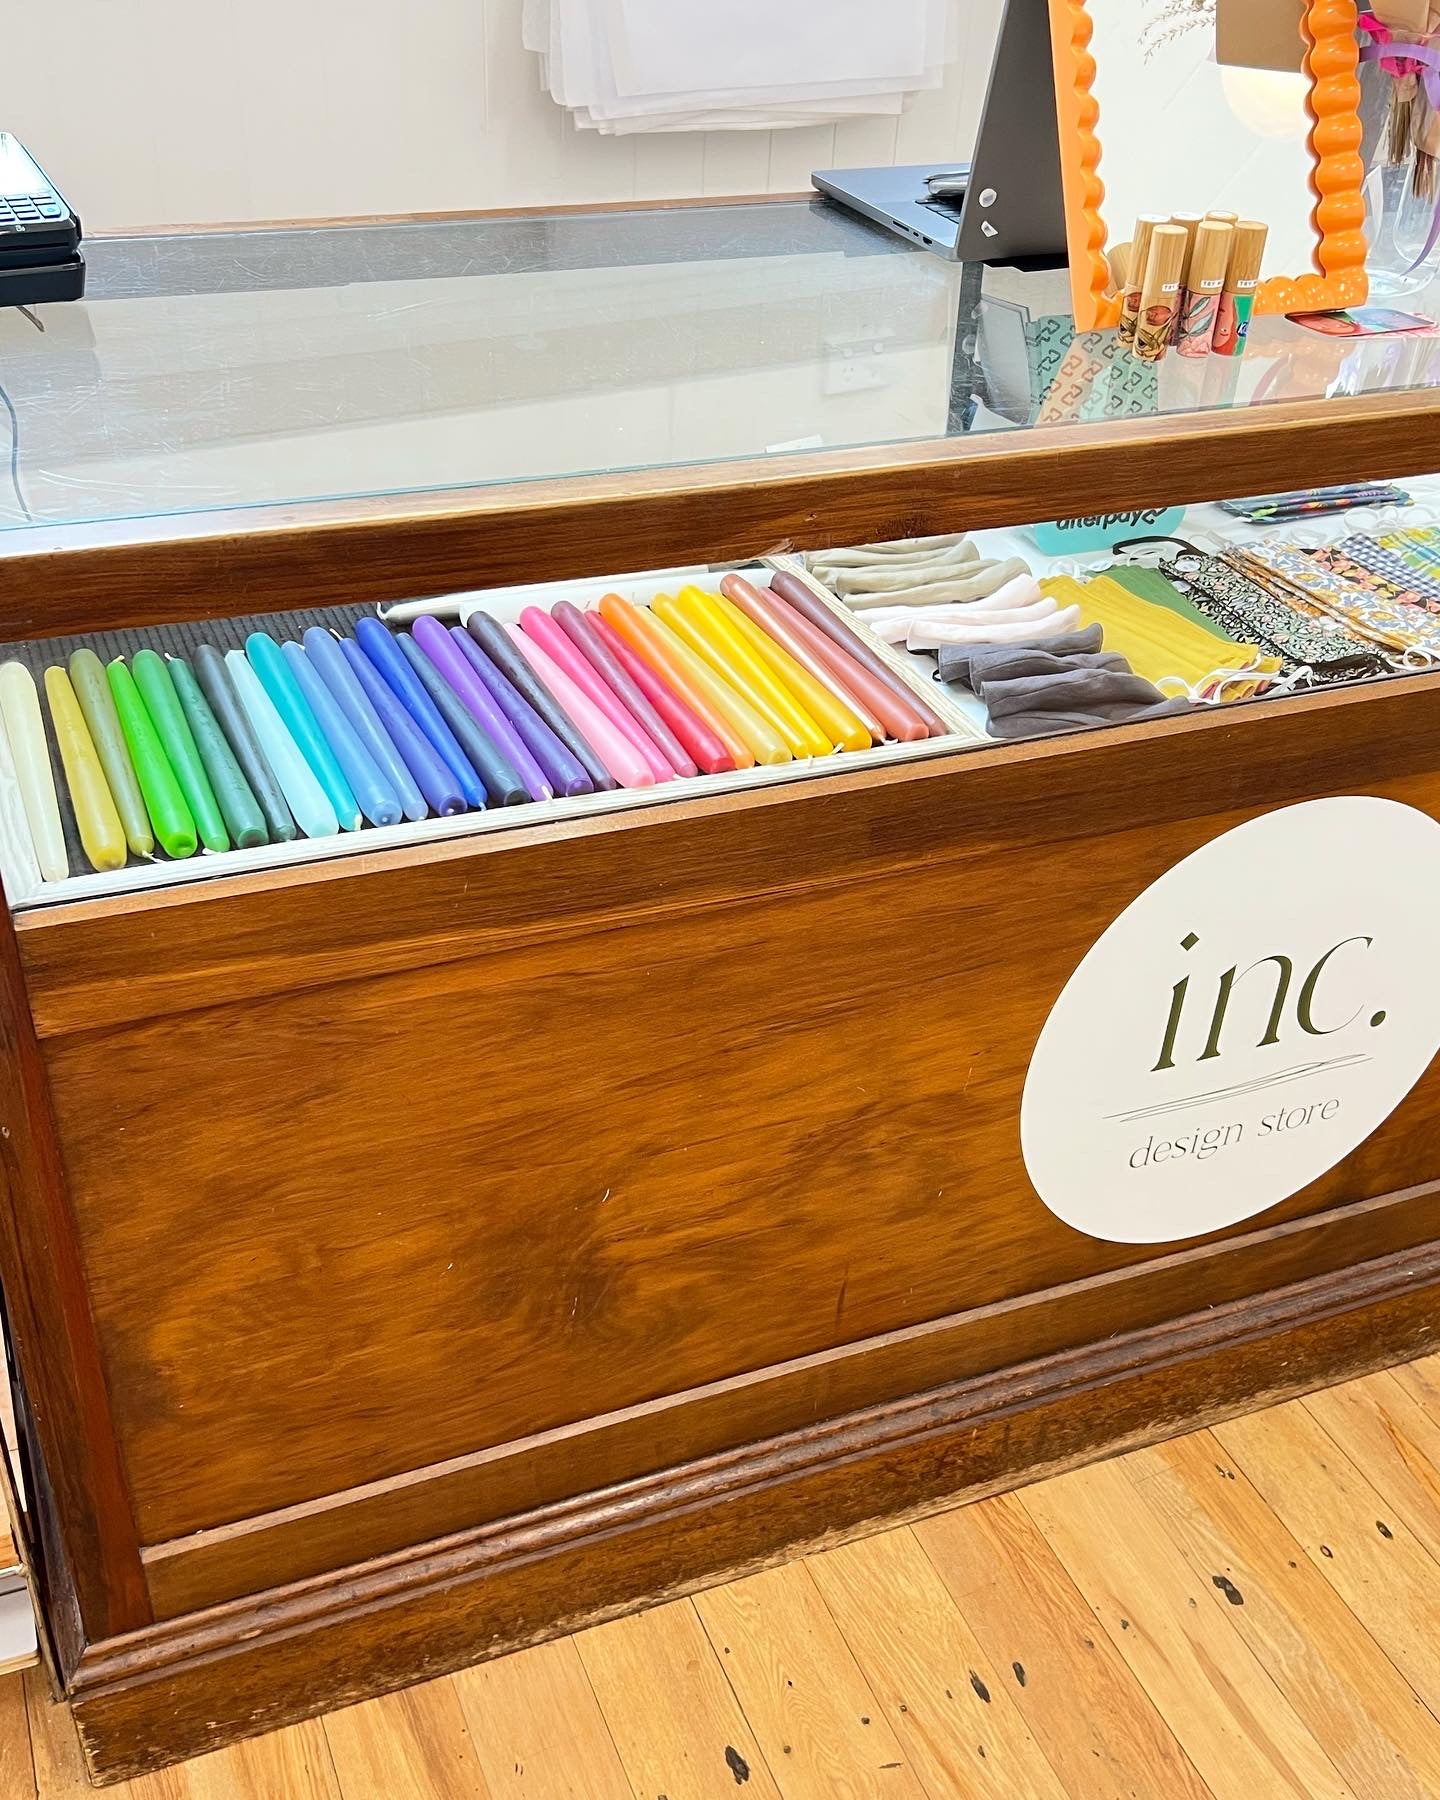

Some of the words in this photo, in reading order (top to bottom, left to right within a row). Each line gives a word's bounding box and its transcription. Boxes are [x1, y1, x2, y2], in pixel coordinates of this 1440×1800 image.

[1150, 931, 1387, 1072] inc.
[1129, 1122, 1244, 1169] design
[1257, 1098, 1340, 1137] store
